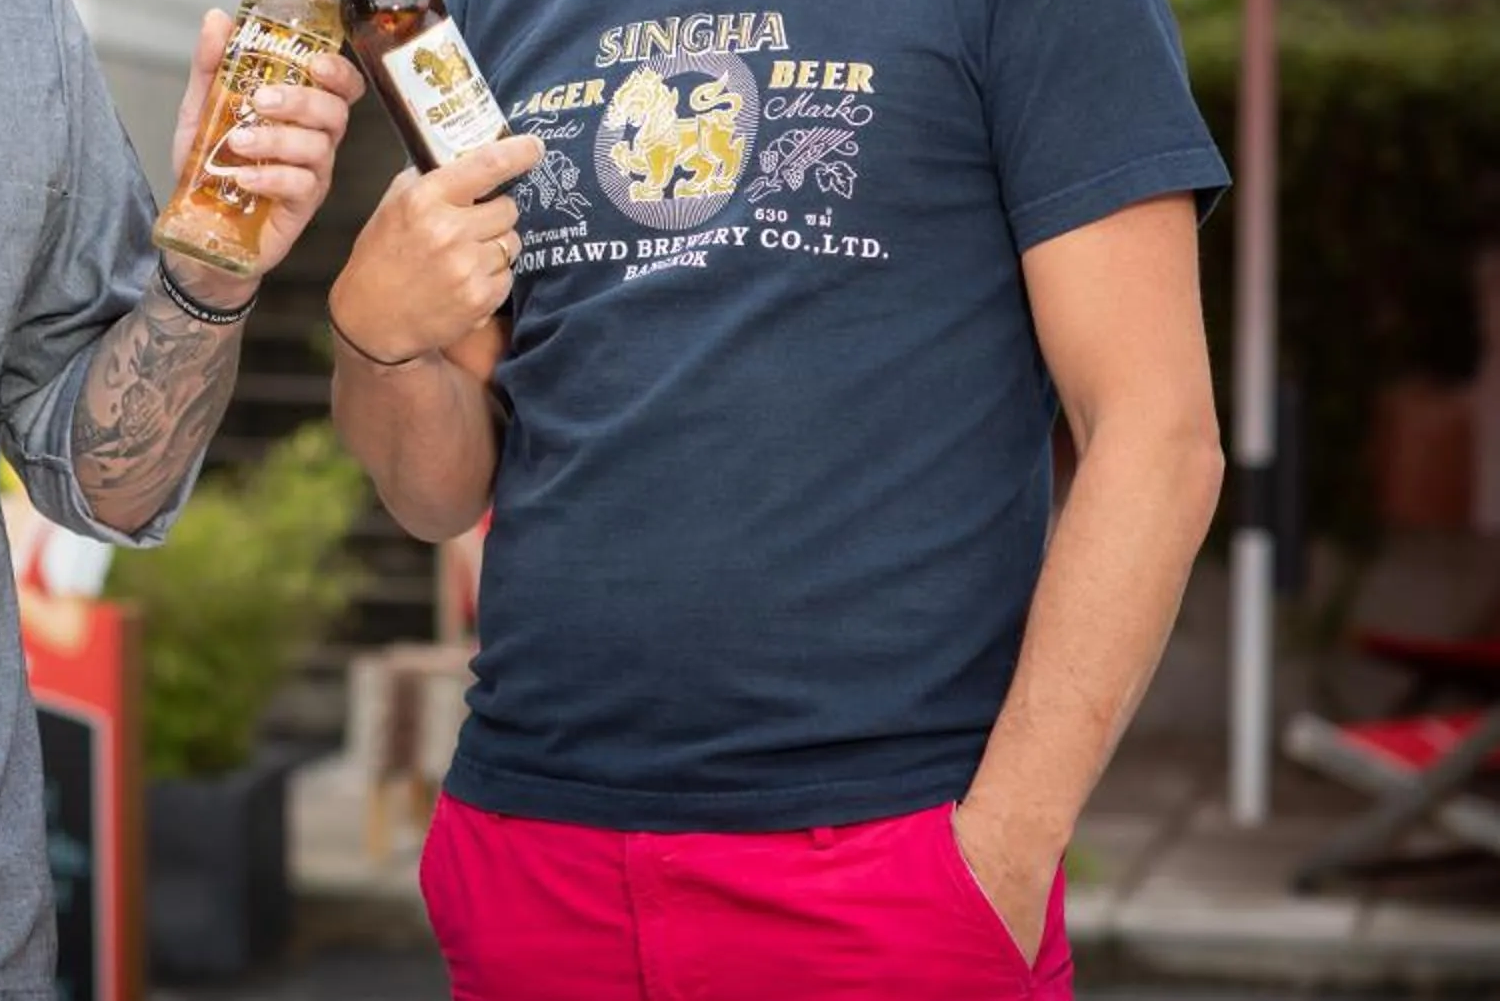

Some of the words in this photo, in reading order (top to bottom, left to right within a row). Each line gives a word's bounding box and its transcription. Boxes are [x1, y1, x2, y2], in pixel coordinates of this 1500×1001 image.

[595, 12, 789, 67] SINGHA
[508, 78, 605, 120] LAGER
[768, 60, 875, 94] BEER
[521, 112, 585, 140] Trade
[764, 95, 874, 126] Mark
[754, 208, 788, 222] 630
[514, 249, 546, 275] OON
[551, 240, 629, 265] RAWD
[636, 226, 750, 259] BREWERY
[760, 228, 890, 260] CO.,LTD.
